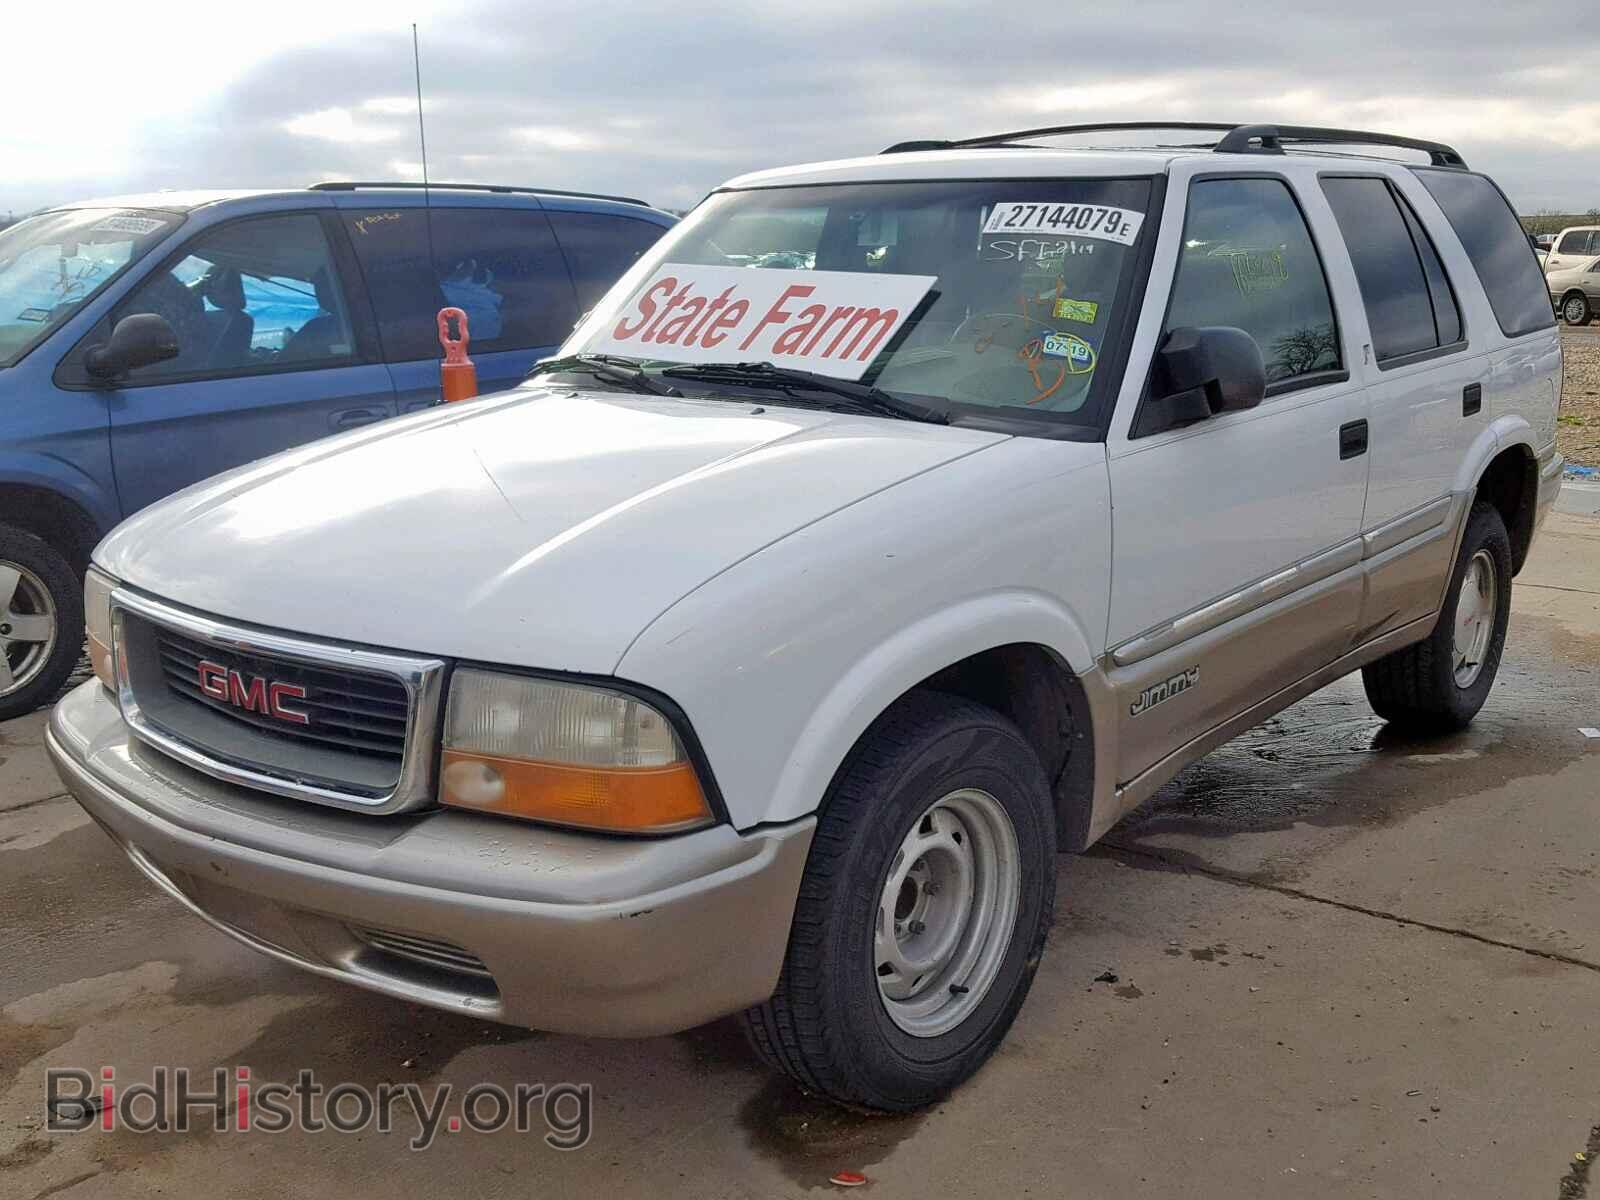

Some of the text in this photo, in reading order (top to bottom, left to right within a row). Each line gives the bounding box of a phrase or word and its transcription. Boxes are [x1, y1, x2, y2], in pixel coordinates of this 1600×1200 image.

[612, 276, 900, 362] State Farm
[198, 660, 309, 725] GMC
